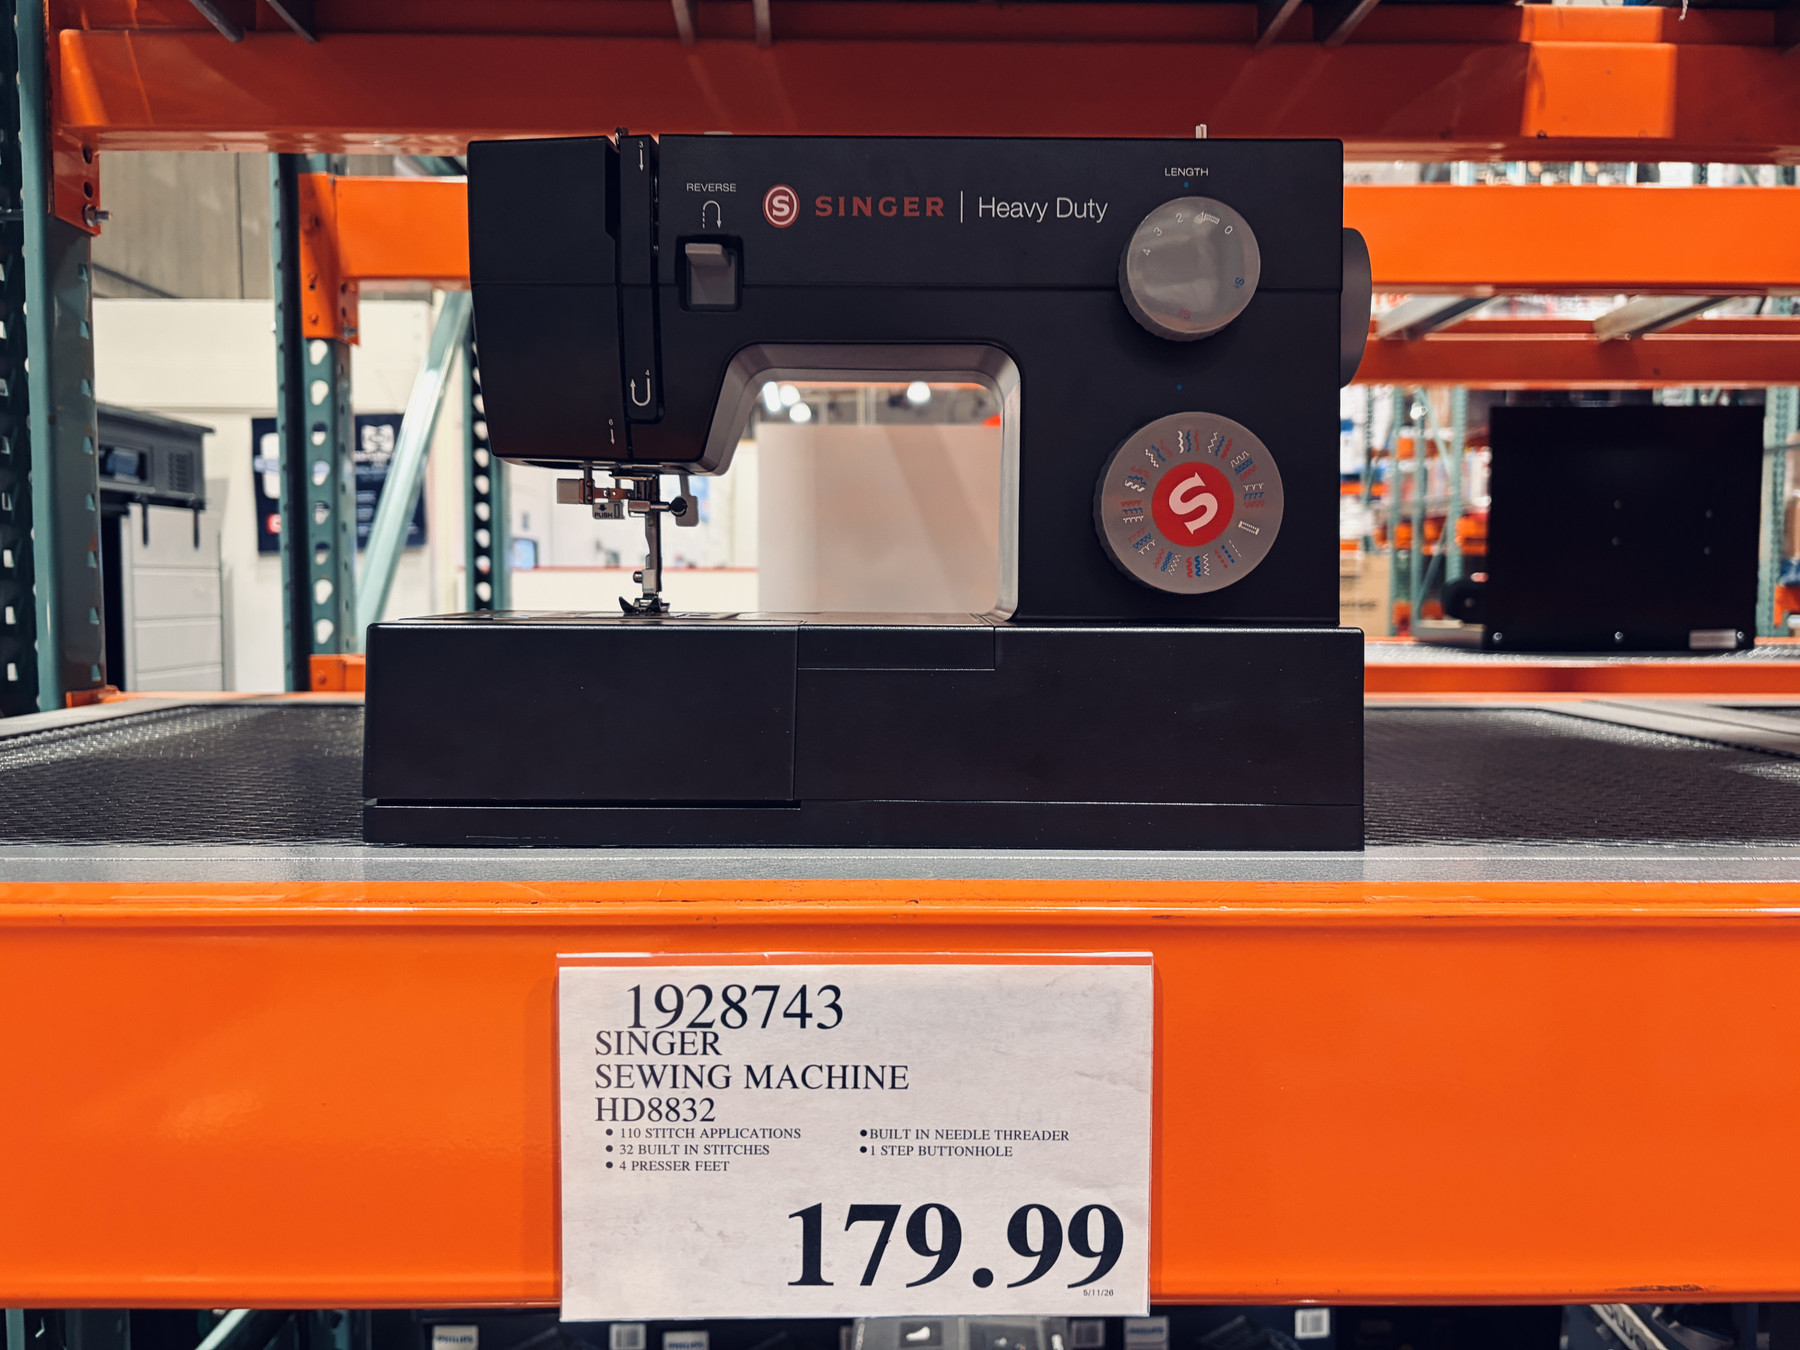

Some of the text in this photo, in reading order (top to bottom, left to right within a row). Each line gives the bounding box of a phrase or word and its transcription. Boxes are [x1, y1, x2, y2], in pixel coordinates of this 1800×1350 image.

[1164, 167, 1209, 177] LENGTH
[686, 182, 736, 192] REVERSE
[815, 195, 1108, 224] SINGER Heavy Duty
[1153, 227, 1163, 237] 3
[1175, 212, 1184, 223] 2
[594, 511, 613, 519] PUSH
[627, 984, 843, 1029] 1928743
[595, 1030, 723, 1056] SINGER
[595, 1063, 909, 1090] SEWING MACHINE
[594, 1097, 716, 1122] HD8832
[621, 1127, 801, 1139] 110 STITCH APPLICATIONS
[870, 1128, 1069, 1141] BUILT IN NEEDLE THREADER
[619, 1144, 770, 1156] 32 BUILT IN STITCHES
[869, 1145, 1013, 1157] 1 STEP BUTTONHOLE
[619, 1160, 730, 1172] 4 PRESSER FEET
[787, 1202, 1124, 1289] 179.99
